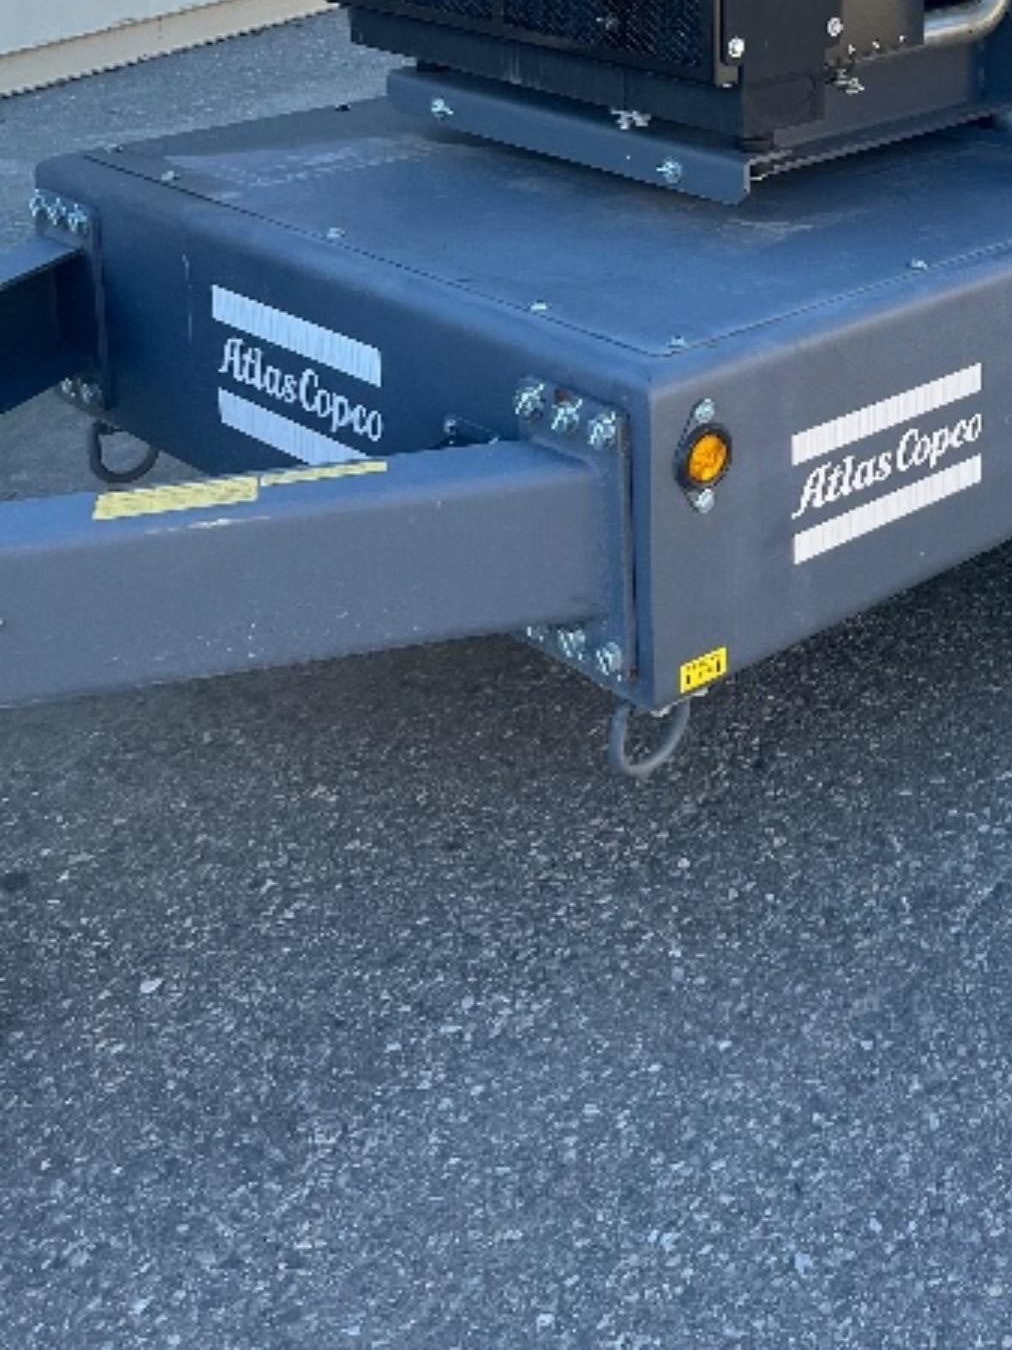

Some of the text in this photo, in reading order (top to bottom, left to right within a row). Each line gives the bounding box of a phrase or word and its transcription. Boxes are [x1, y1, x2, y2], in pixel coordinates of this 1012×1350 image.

[217, 337, 383, 442] Atlas Copco
[791, 412, 982, 520] Atlas Copco
